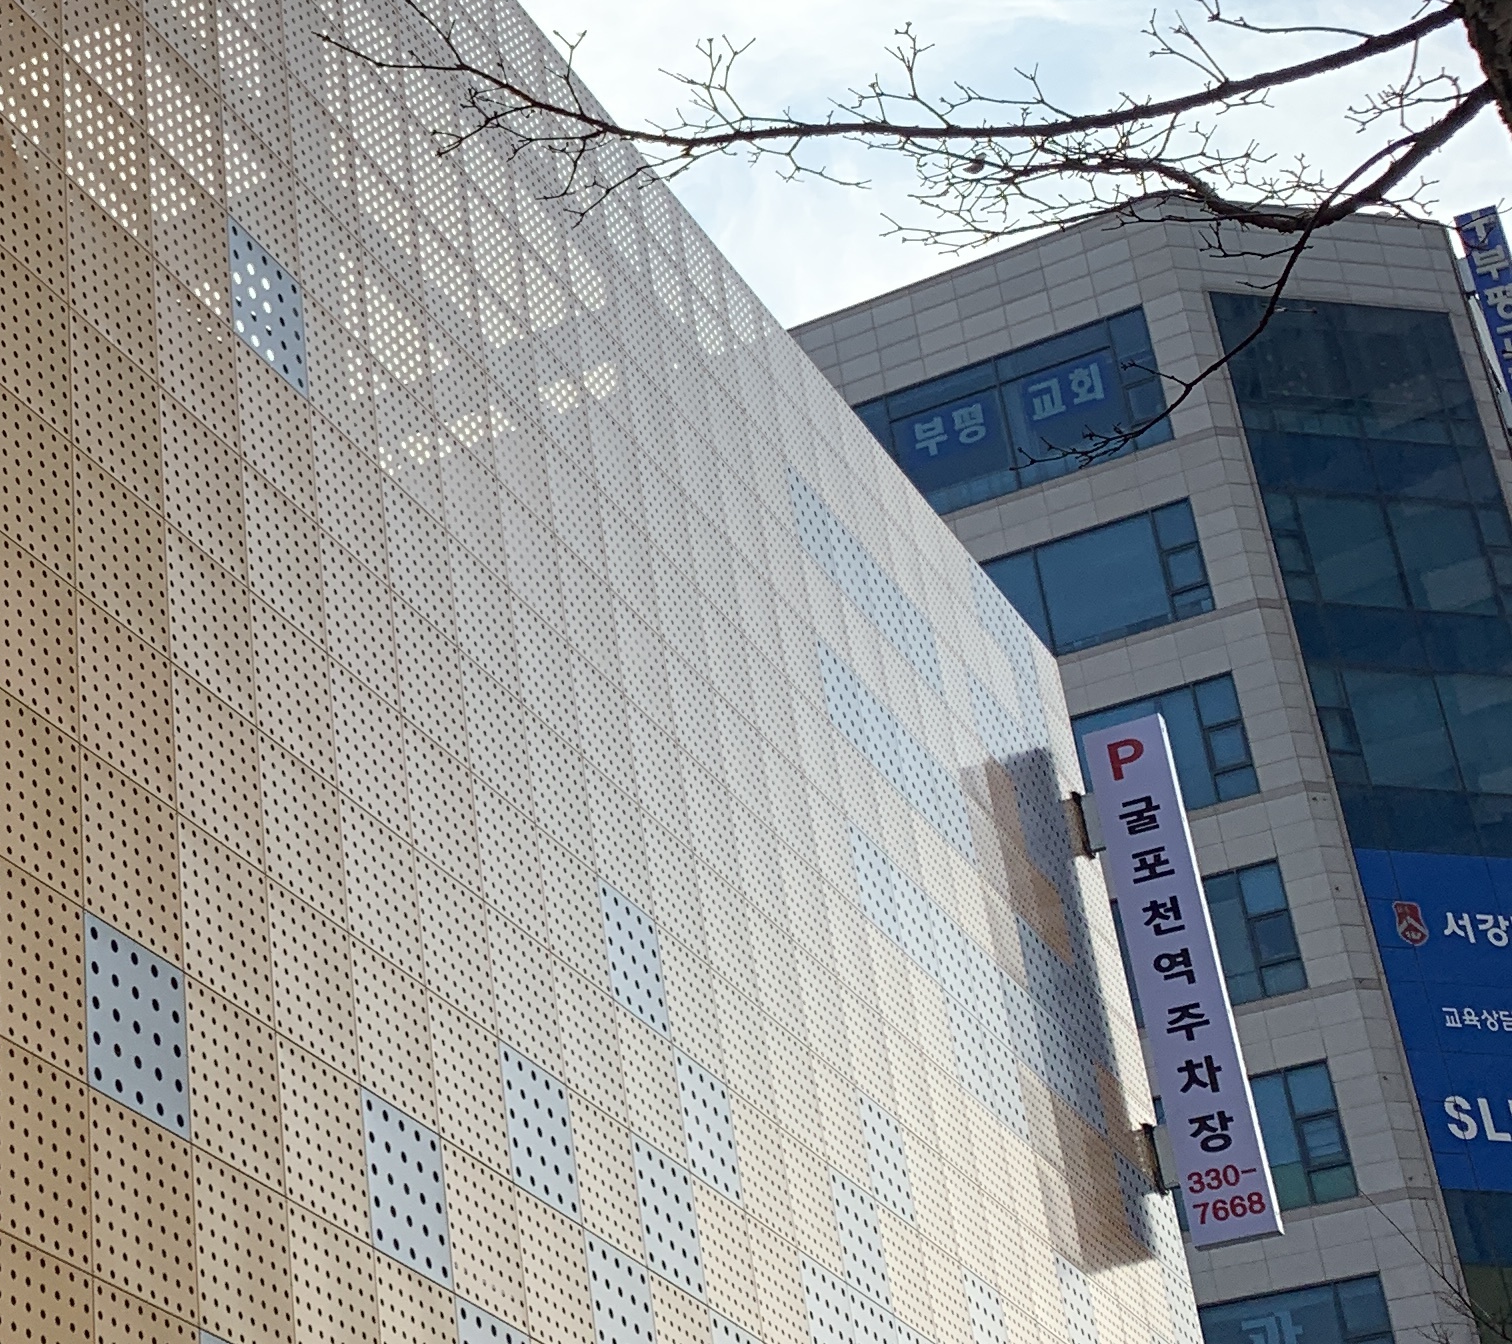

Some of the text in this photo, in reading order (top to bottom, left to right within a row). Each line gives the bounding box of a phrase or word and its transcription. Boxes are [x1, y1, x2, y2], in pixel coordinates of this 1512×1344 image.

[913, 362, 1105, 456] 부평 교회
[1106, 738, 1144, 781] P
[1444, 911, 1512, 947] 서강
[1119, 795, 1234, 1153] 굴포천역주차장
[1444, 1095, 1512, 1142] SL
[1187, 1164, 1257, 1194] 330-
[1192, 1191, 1266, 1225] 7668
